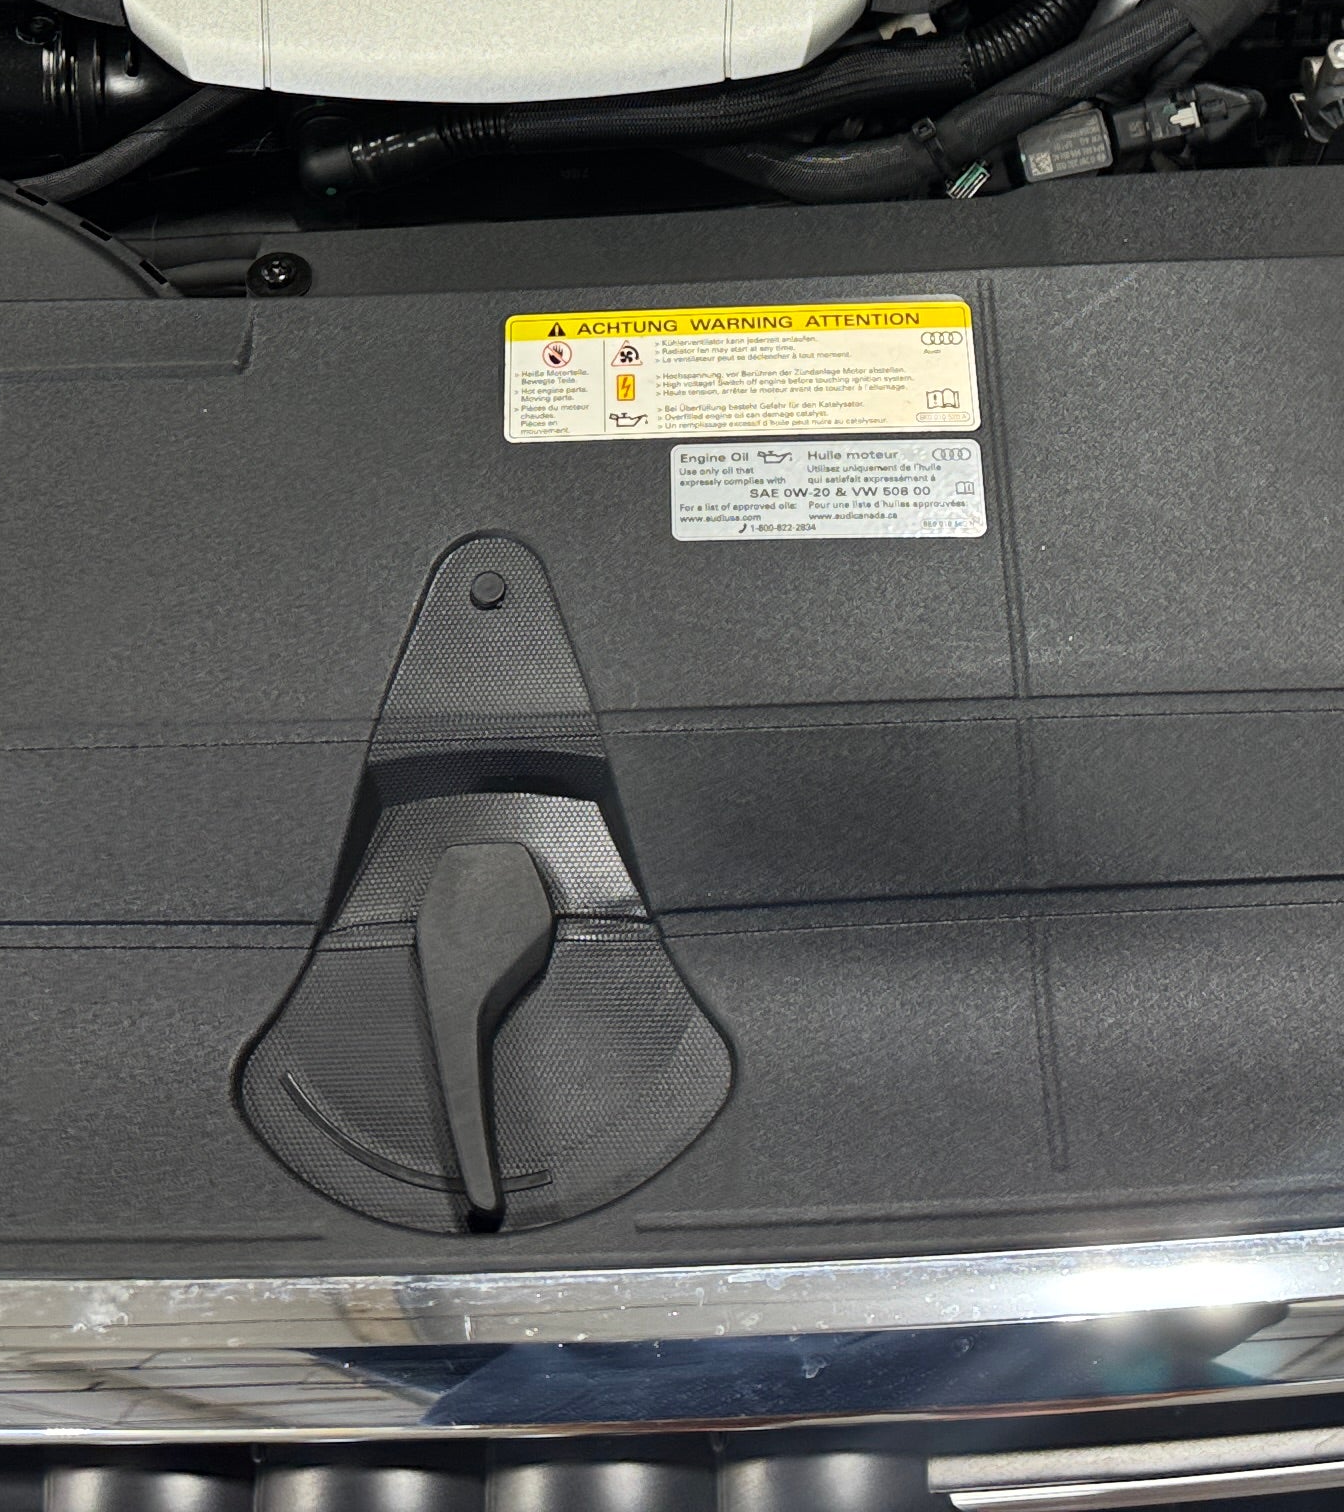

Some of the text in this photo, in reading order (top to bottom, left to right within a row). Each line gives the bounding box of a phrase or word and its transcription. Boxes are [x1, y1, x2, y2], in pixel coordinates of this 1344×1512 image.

[577, 312, 921, 335] ACHTUNG WARNING ATTENTION
[680, 452, 749, 464] Engine Oil
[808, 450, 899, 460] Huile moteur
[700, 467, 719, 477] only
[722, 467, 733, 475] oil
[736, 466, 754, 474] that
[807, 464, 840, 473] Utilisez
[843, 464, 898, 473] uniquement
[680, 476, 786, 487] expressly complies with
[808, 476, 822, 484] qui
[826, 475, 860, 484] satisfait
[750, 486, 931, 498] SAE 0W-20 & VW 508 00
[679, 504, 693, 512] For
[705, 503, 718, 511] list
[721, 503, 731, 511] of
[733, 503, 775, 512] approved
[808, 501, 830, 509] Pour
[680, 514, 761, 522] www.audiusa.com
[809, 512, 898, 520] www.audicanada.ca
